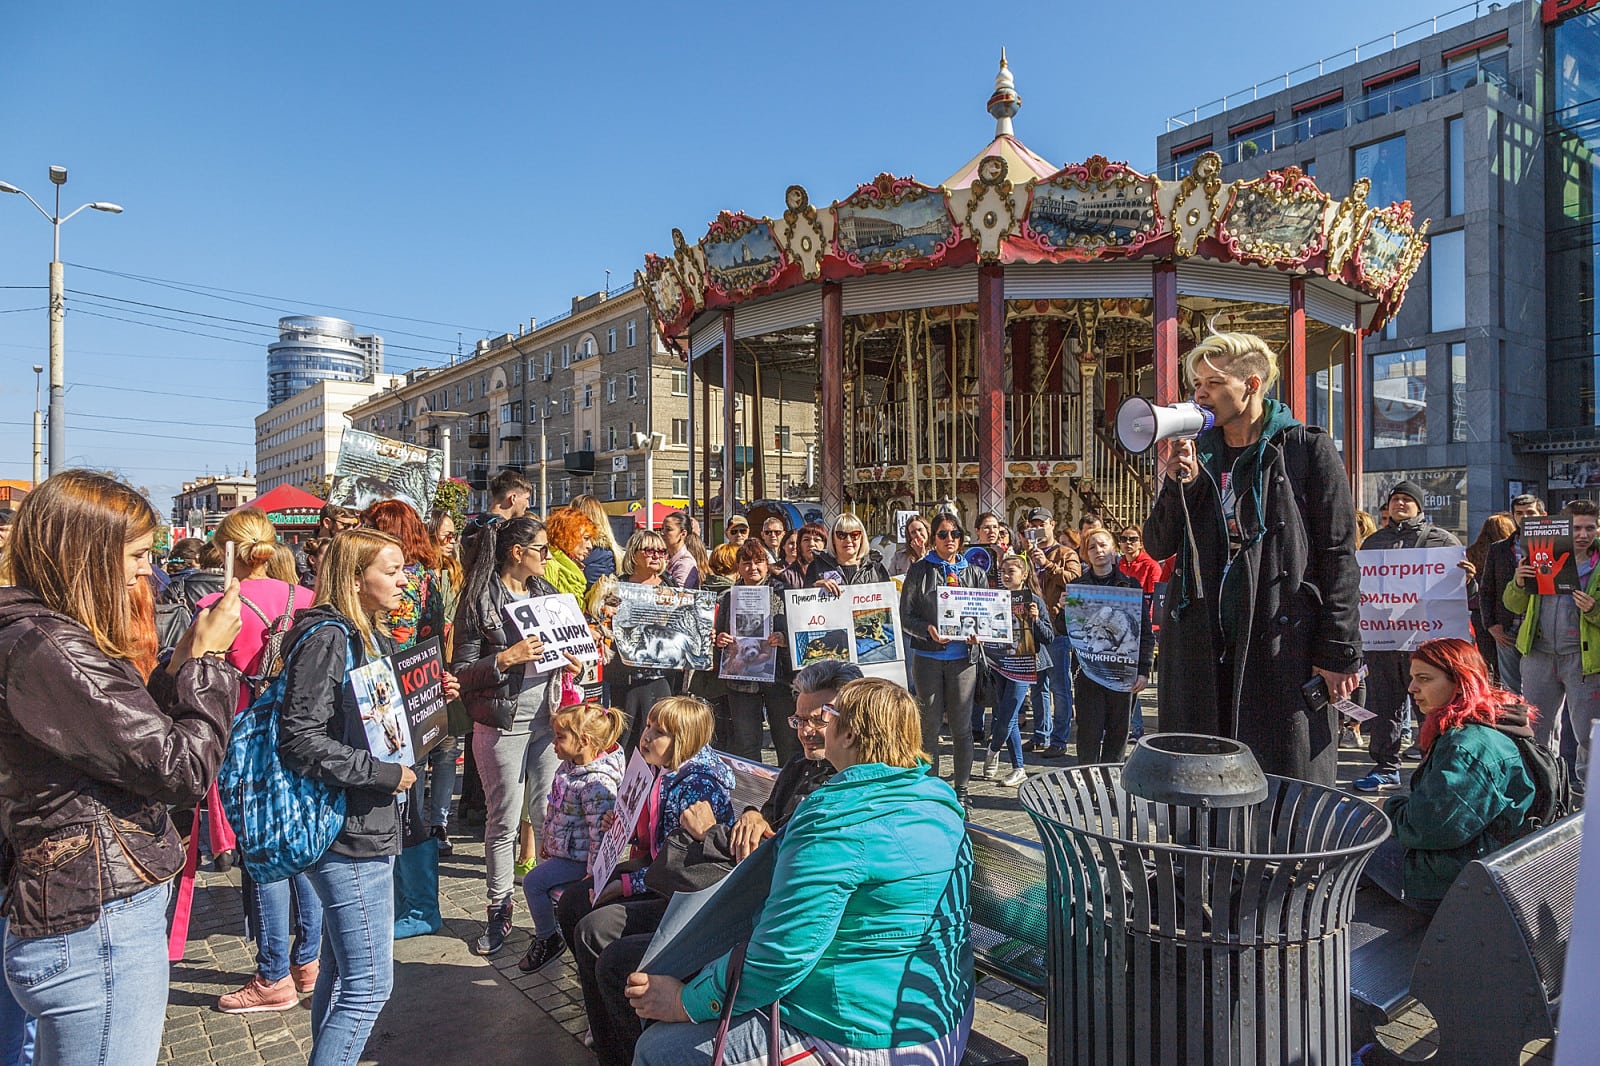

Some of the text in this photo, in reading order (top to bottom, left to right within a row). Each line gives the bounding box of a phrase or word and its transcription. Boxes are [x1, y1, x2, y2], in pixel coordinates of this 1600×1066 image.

[342, 434, 428, 462] ы чувствуем
[267, 512, 321, 525] Shawar
[1533, 529, 1560, 537] ПРИЮТА
[1360, 563, 1446, 579] мотрите
[619, 588, 695, 606] Мы чувствуем
[792, 593, 817, 605] Приют
[853, 593, 882, 604] ПОСЛЕ
[514, 604, 540, 630] Я
[807, 615, 826, 626] ДО
[1360, 619, 1444, 632] емляне»
[527, 624, 589, 645] А ЦИРК
[559, 642, 596, 656] ТВАРИН
[398, 646, 438, 671] ГОВОРИ ЗА ТЕХ
[401, 659, 440, 695] КОГО
[408, 695, 420, 711] НЕ
